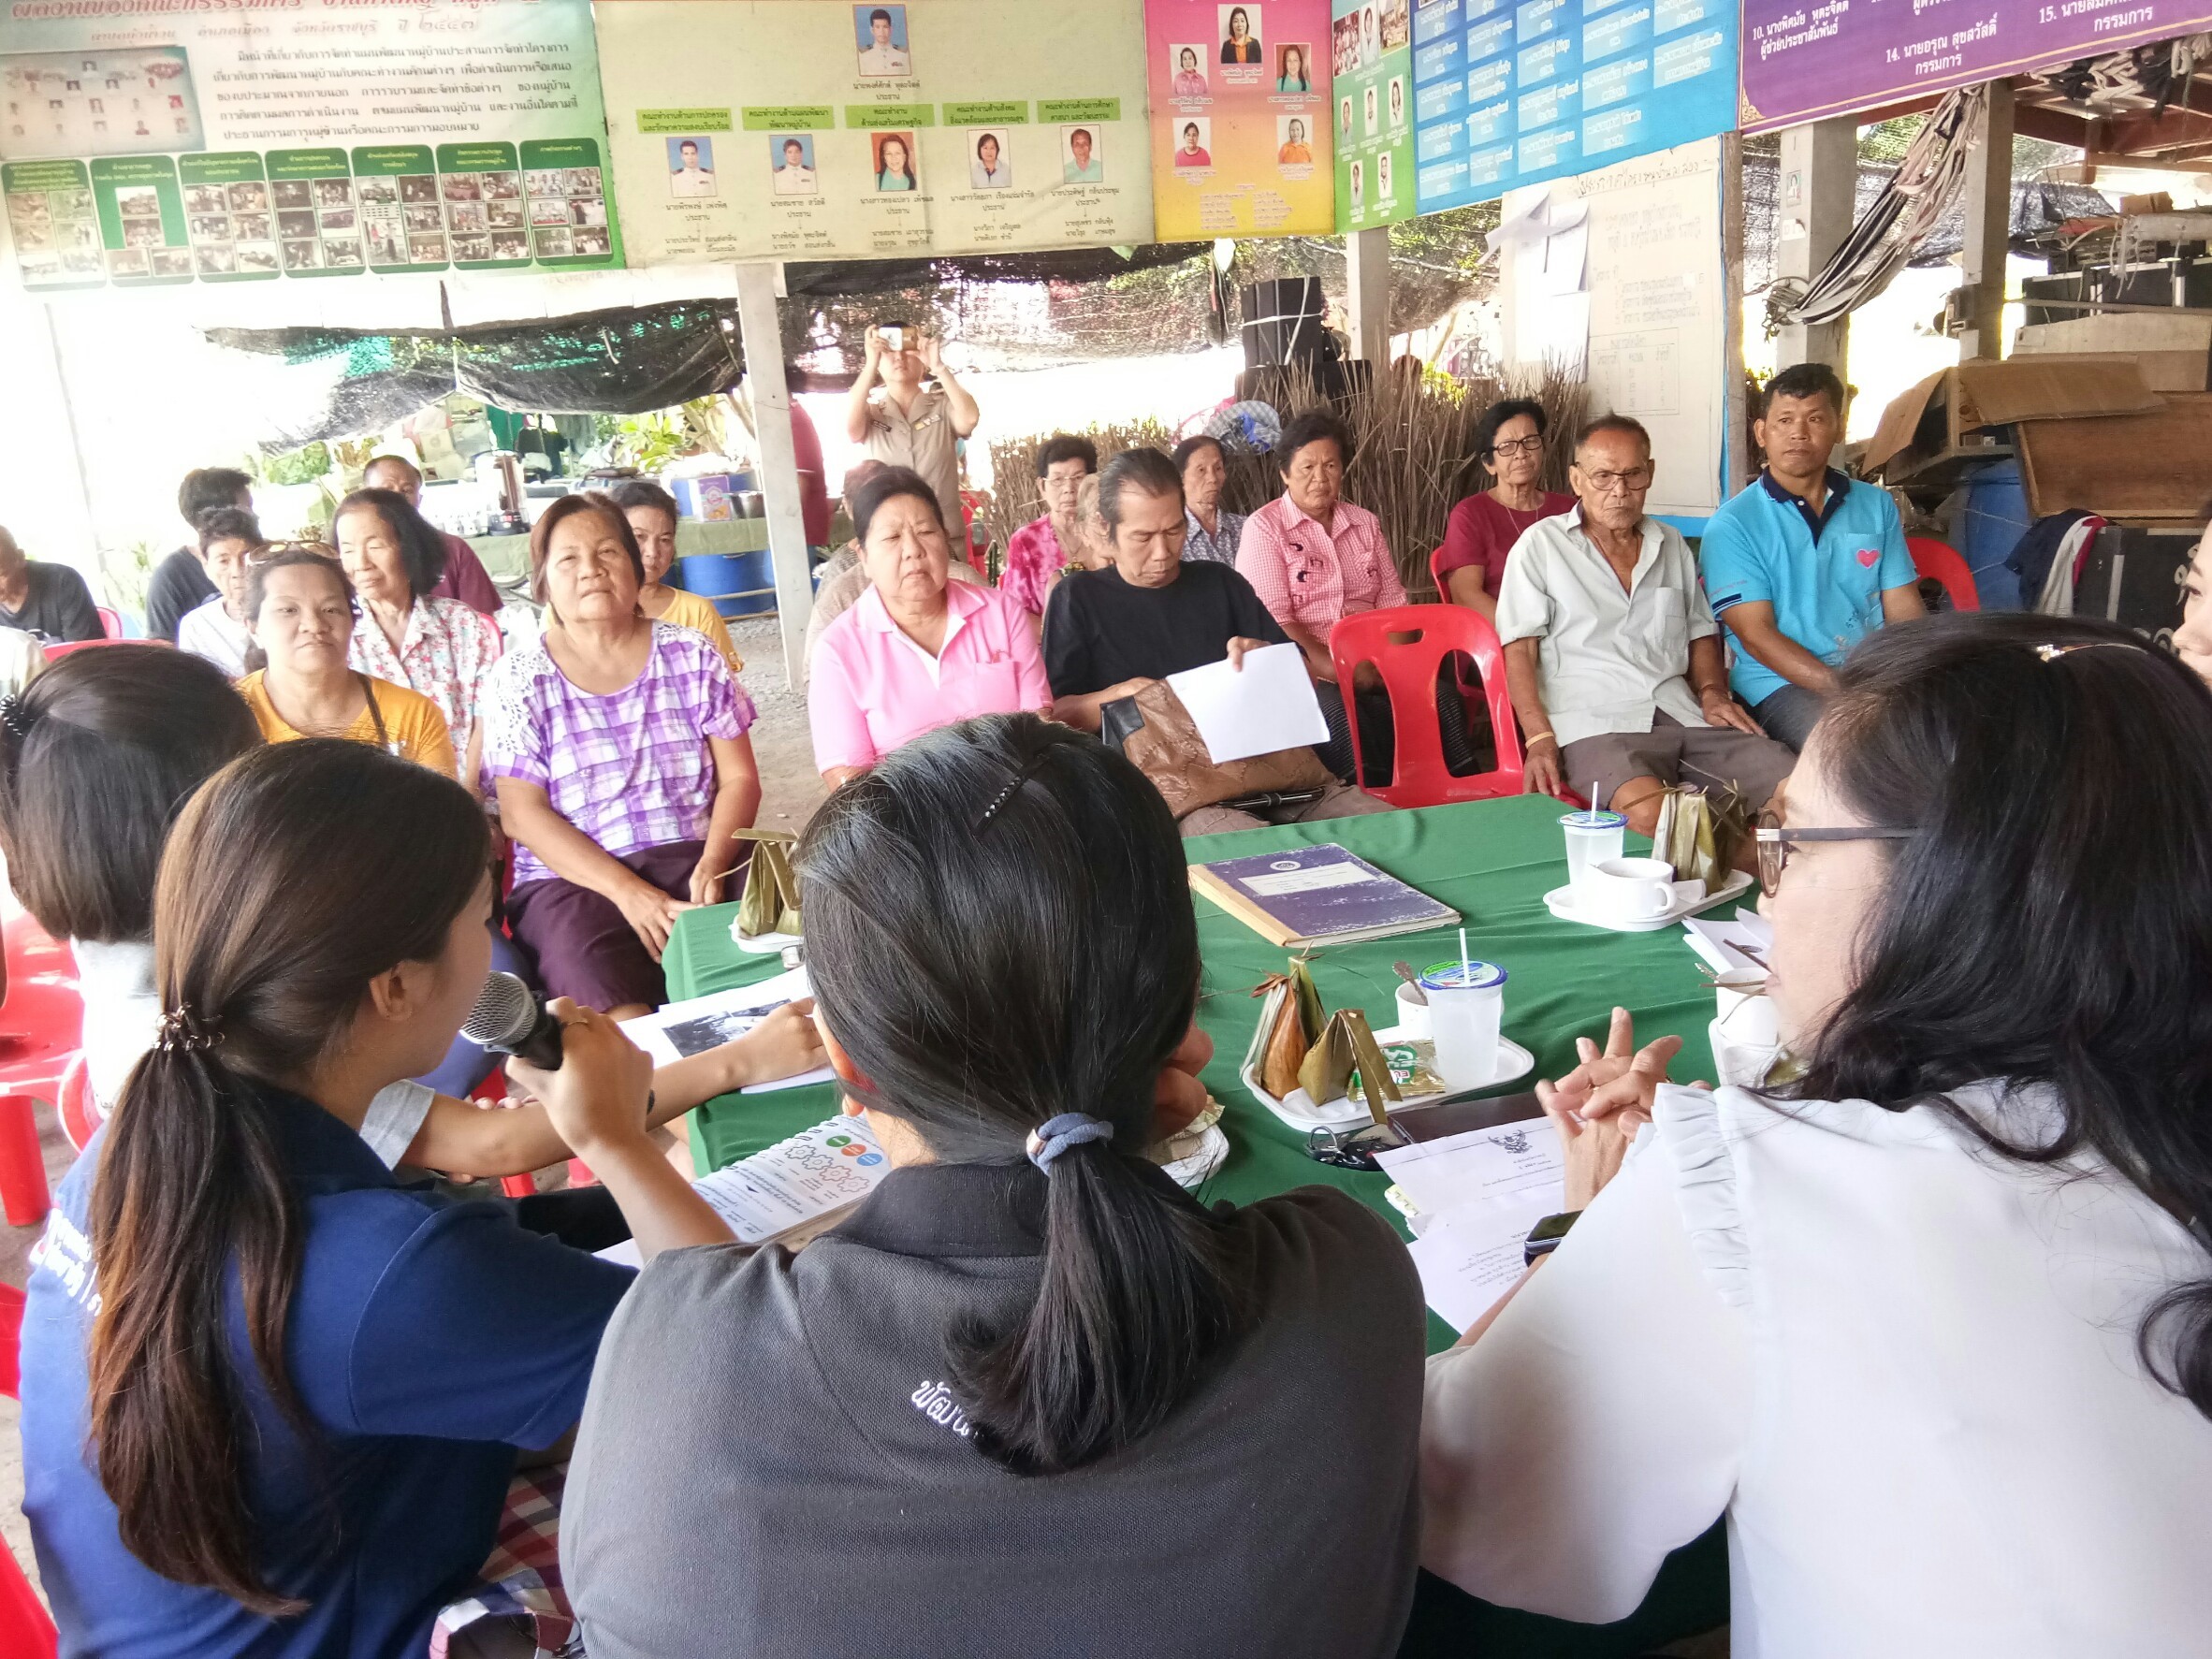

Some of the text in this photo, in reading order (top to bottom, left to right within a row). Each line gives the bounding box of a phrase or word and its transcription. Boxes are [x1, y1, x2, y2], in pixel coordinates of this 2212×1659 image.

[1753, 26, 1764, 40] 10.
[1767, 9, 1806, 36] นางพิศมัย
[2039, 6, 2057, 23] 15.
[2094, 7, 2153, 32] กรรมการ
[1761, 16, 1840, 60] ผู้ช่วยประชาสัมพันธ์
[1886, 12, 1998, 63] 14. นายอรุณ สุขสวัสดิ์
[1915, 53, 1962, 75] กรรมการ
